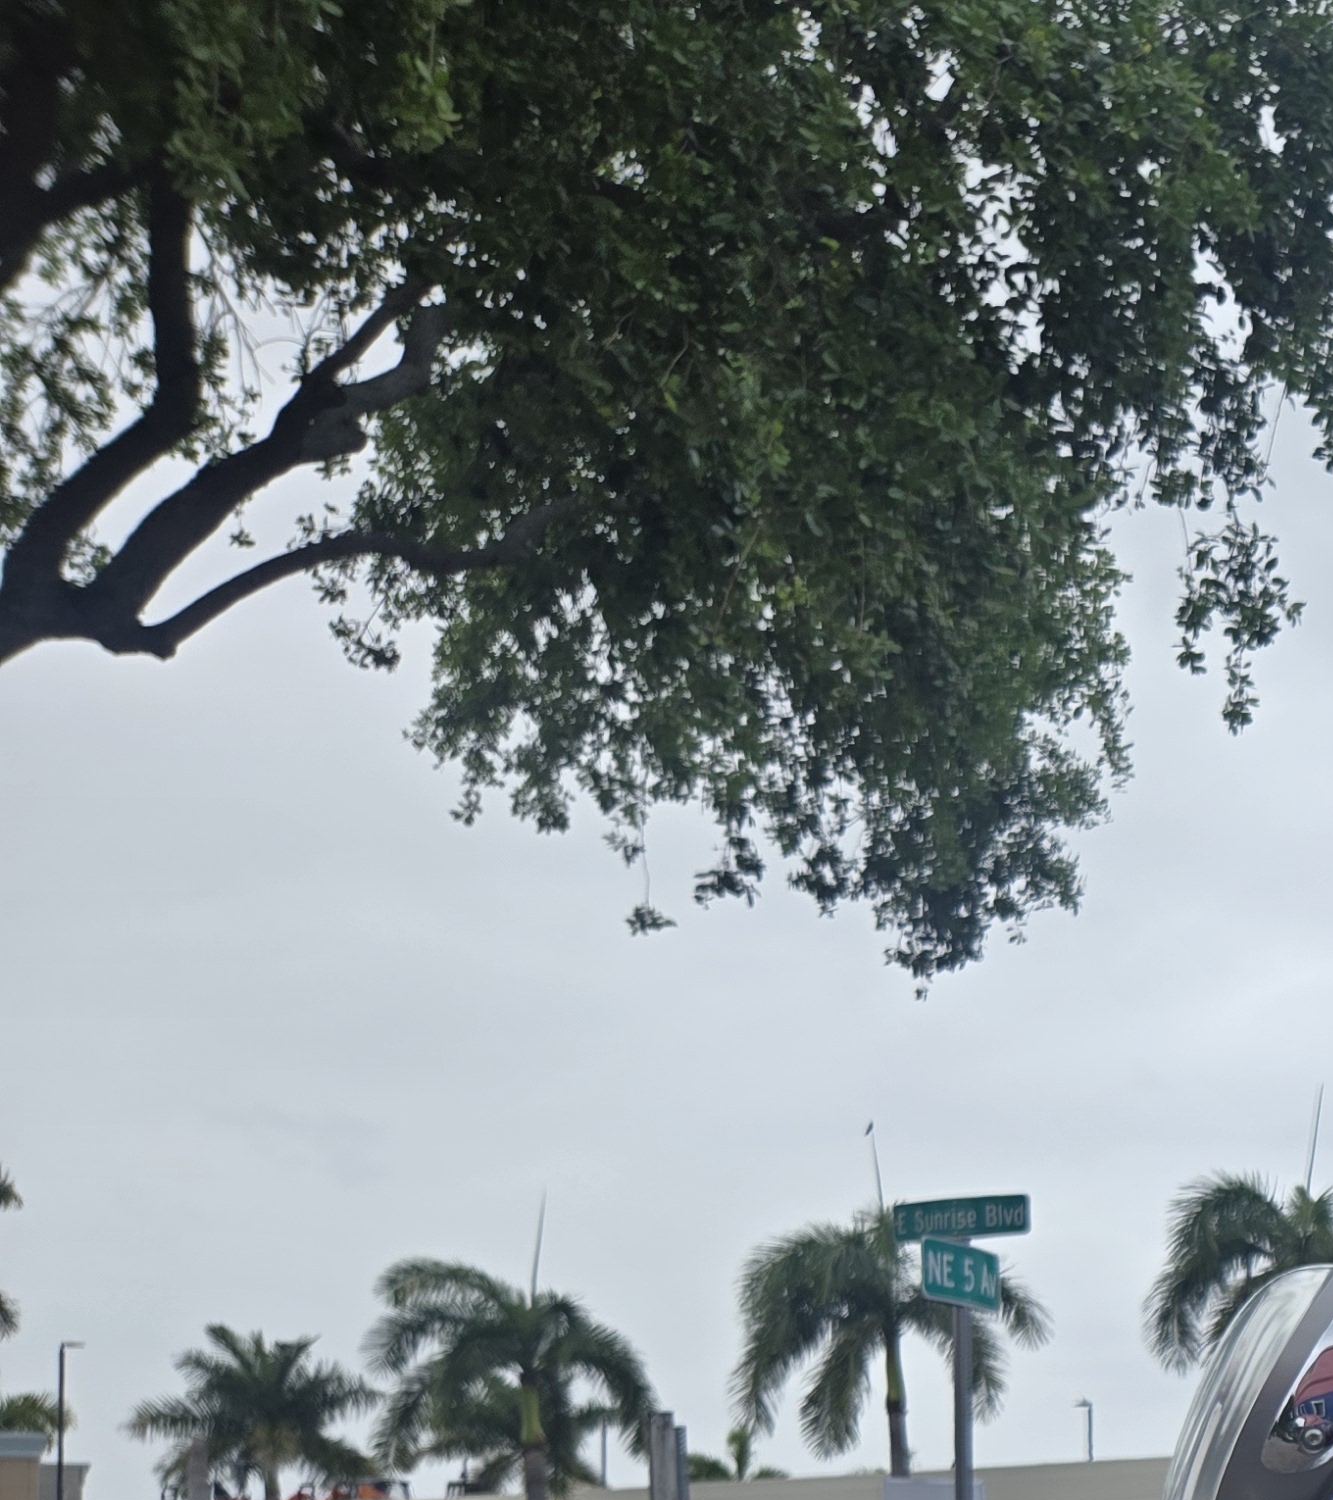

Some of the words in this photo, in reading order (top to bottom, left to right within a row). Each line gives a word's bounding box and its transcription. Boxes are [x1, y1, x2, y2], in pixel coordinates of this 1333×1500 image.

[896, 1213, 908, 1235] E
[914, 1206, 977, 1233] Sunrise
[985, 1203, 1025, 1228] Blvd
[927, 1250, 956, 1289] NE
[963, 1258, 976, 1293] 5
